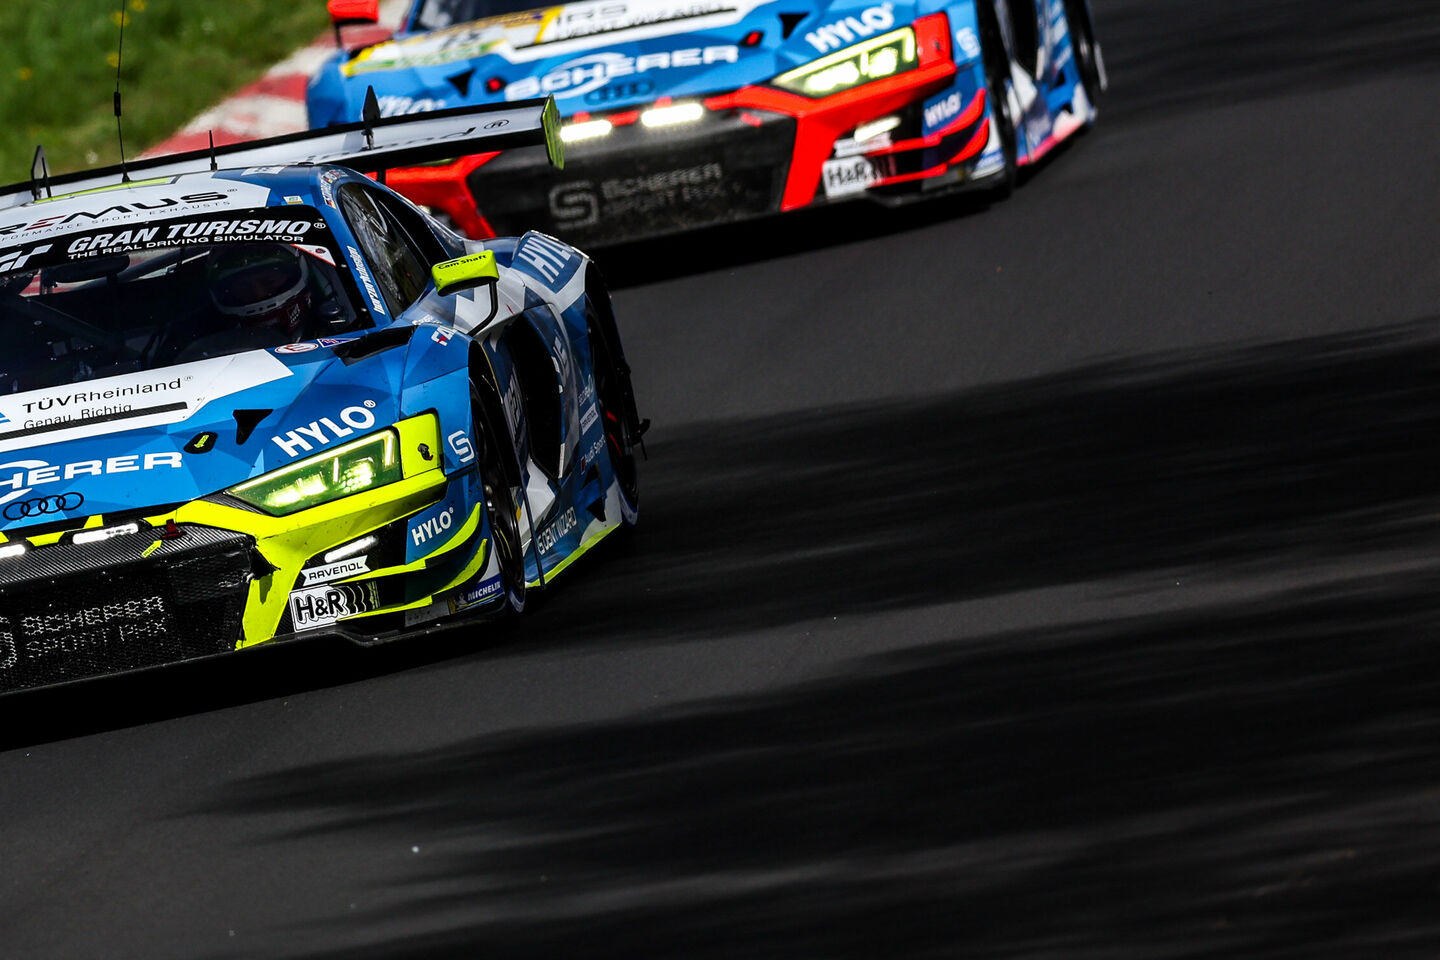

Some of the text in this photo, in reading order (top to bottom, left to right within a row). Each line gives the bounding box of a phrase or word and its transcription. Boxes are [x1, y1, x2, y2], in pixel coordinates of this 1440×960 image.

[91, 212, 141, 225] SPORT
[148, 200, 232, 217] EXHAUSTS
[67, 219, 312, 254] GRAN TURISMO
[68, 234, 305, 260] THE REAL DRIVING SIMULATOR
[22, 378, 182, 414] TÜVRheinland
[271, 405, 376, 458] HYLO
[411, 510, 453, 546] HYLO
[308, 560, 364, 581] RAVENOL
[21, 596, 166, 636] SCHERER
[295, 590, 349, 623] H&R
